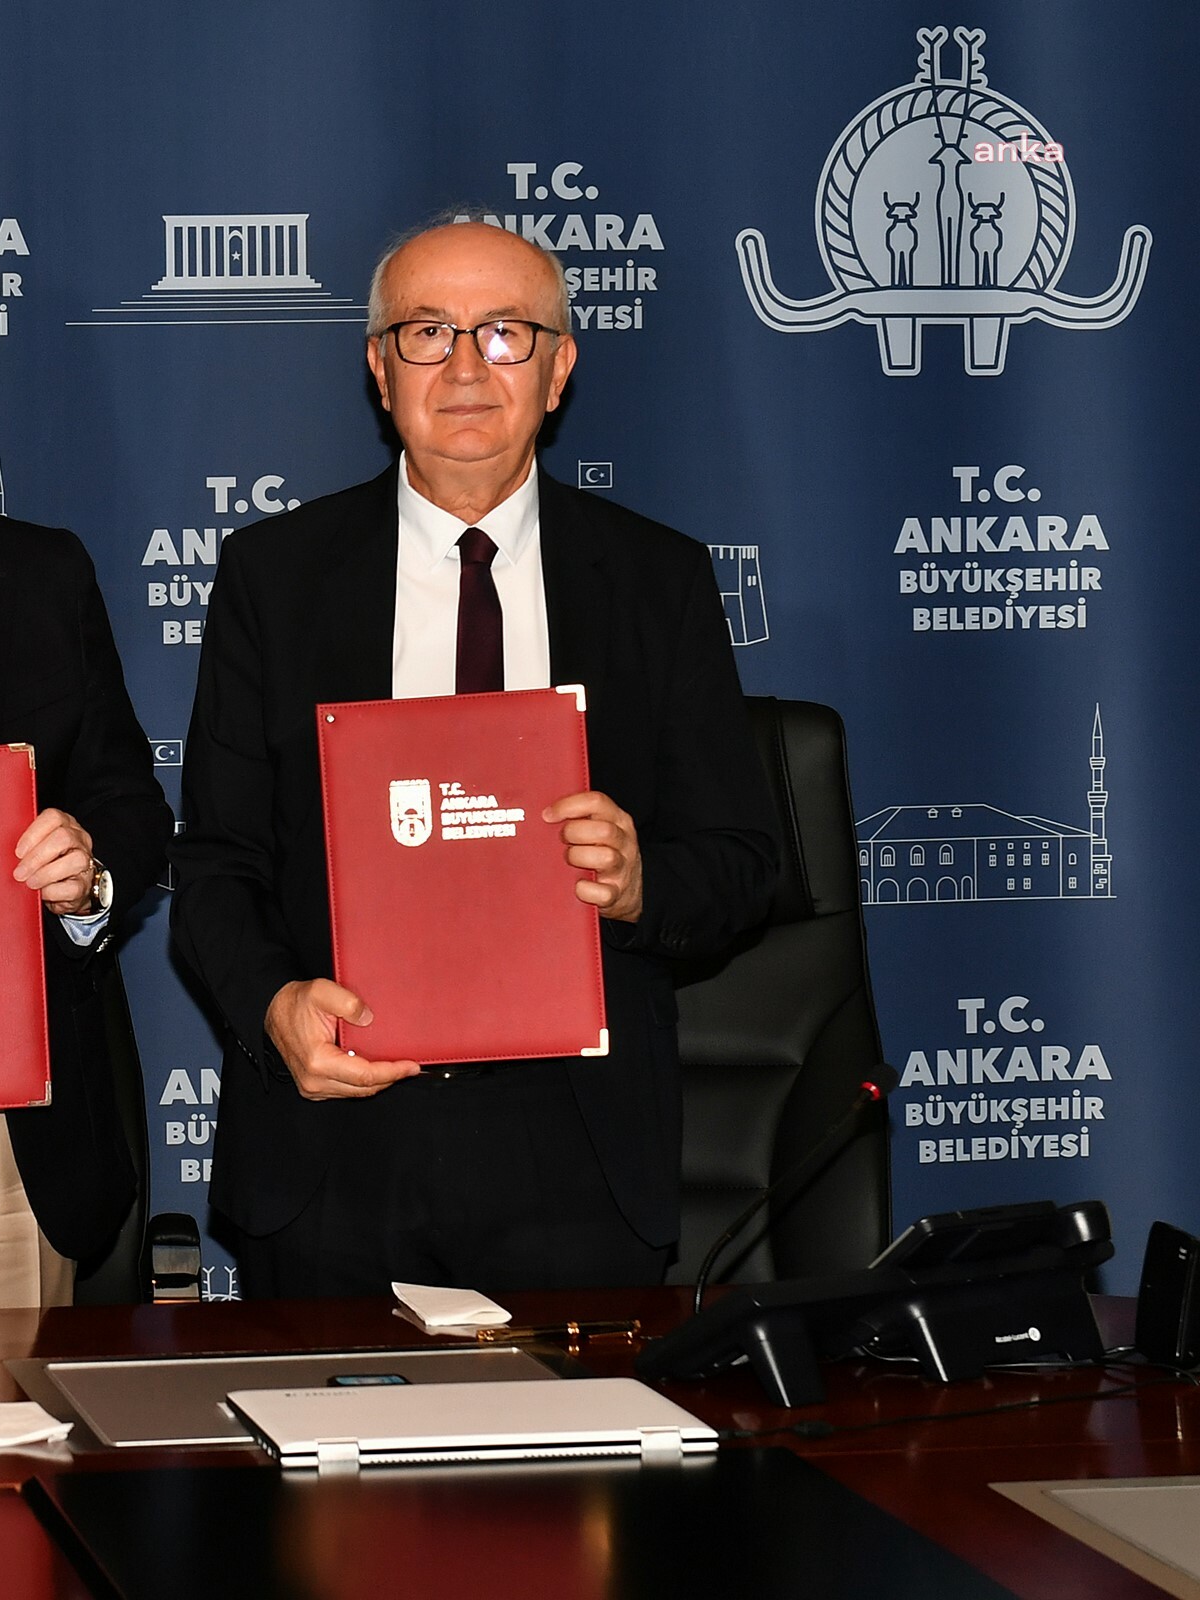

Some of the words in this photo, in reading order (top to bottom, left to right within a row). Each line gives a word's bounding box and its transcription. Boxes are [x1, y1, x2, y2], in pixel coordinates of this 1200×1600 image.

[507, 162, 599, 200] T.C.
[564, 259, 658, 299] ŞEHİR
[206, 474, 302, 514] T.C.
[952, 465, 1041, 503] T.C.
[893, 514, 1110, 554] ANKARA
[899, 559, 1103, 599] BÜYÜKŞEHİR
[913, 597, 1087, 632] BELEDİYESİ
[957, 996, 1045, 1034] T.C.
[899, 1045, 1113, 1087] ANKARA
[905, 1089, 1105, 1129] BÜYÜKŞEHİR
[919, 1126, 1090, 1163] BELEDİYESİ
